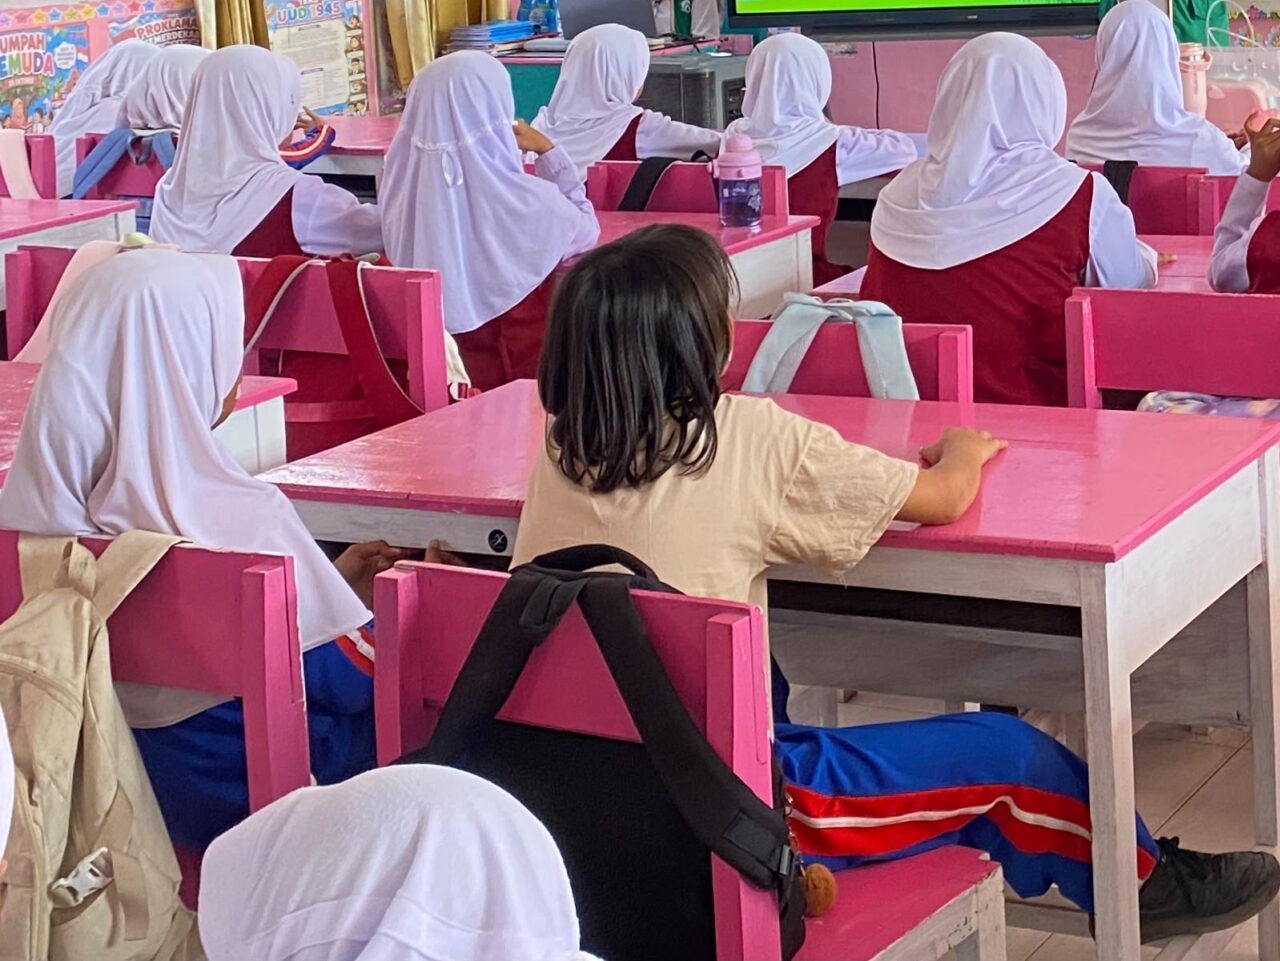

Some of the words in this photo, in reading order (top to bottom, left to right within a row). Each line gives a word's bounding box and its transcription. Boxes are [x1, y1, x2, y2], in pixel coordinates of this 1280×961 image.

[278, 8, 308, 22] UUD
[310, 2, 340, 16] 1945
[136, 18, 201, 39] PROKLAMA
[0, 34, 44, 52] UMPAH
[0, 52, 53, 77] EMUDA
